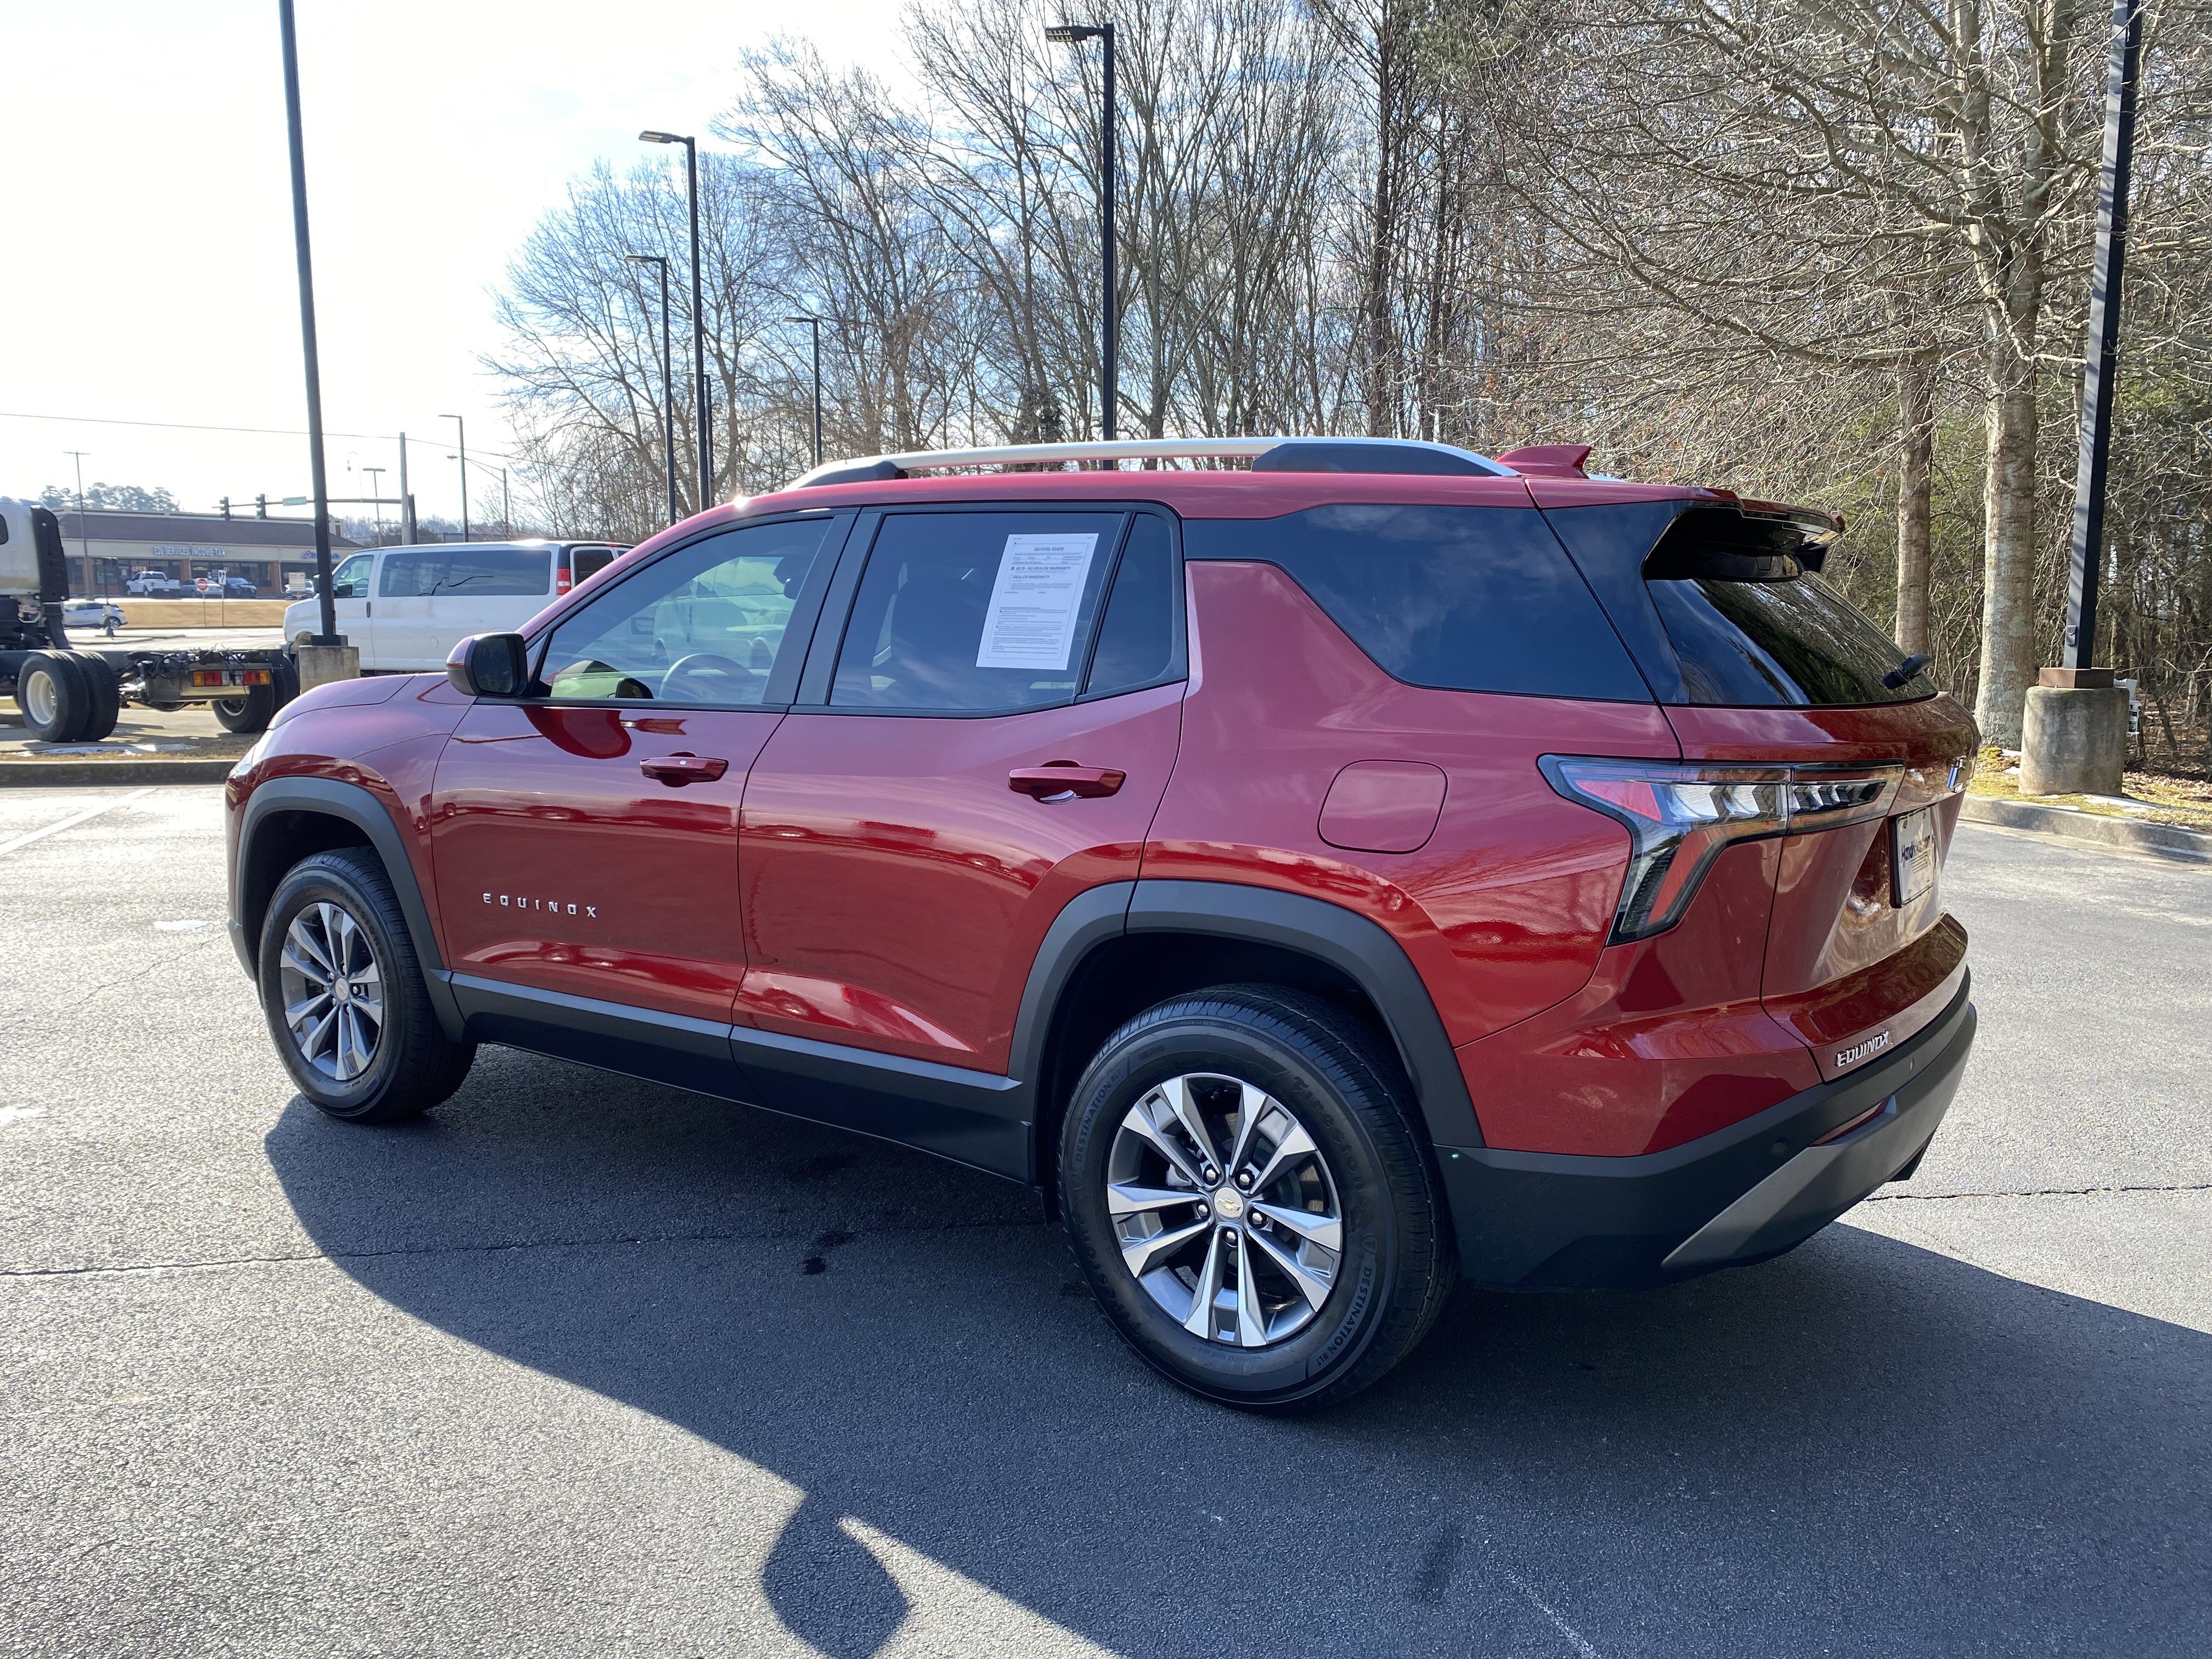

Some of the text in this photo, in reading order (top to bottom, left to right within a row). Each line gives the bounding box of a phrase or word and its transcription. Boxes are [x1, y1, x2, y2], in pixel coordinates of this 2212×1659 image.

[483, 893, 596, 918] EQUINOX
[1836, 1030, 1889, 1067] EQUINOX
[1076, 1081, 1111, 1164] DESTINATION
[1327, 1266, 1372, 1355] DESTINATION
